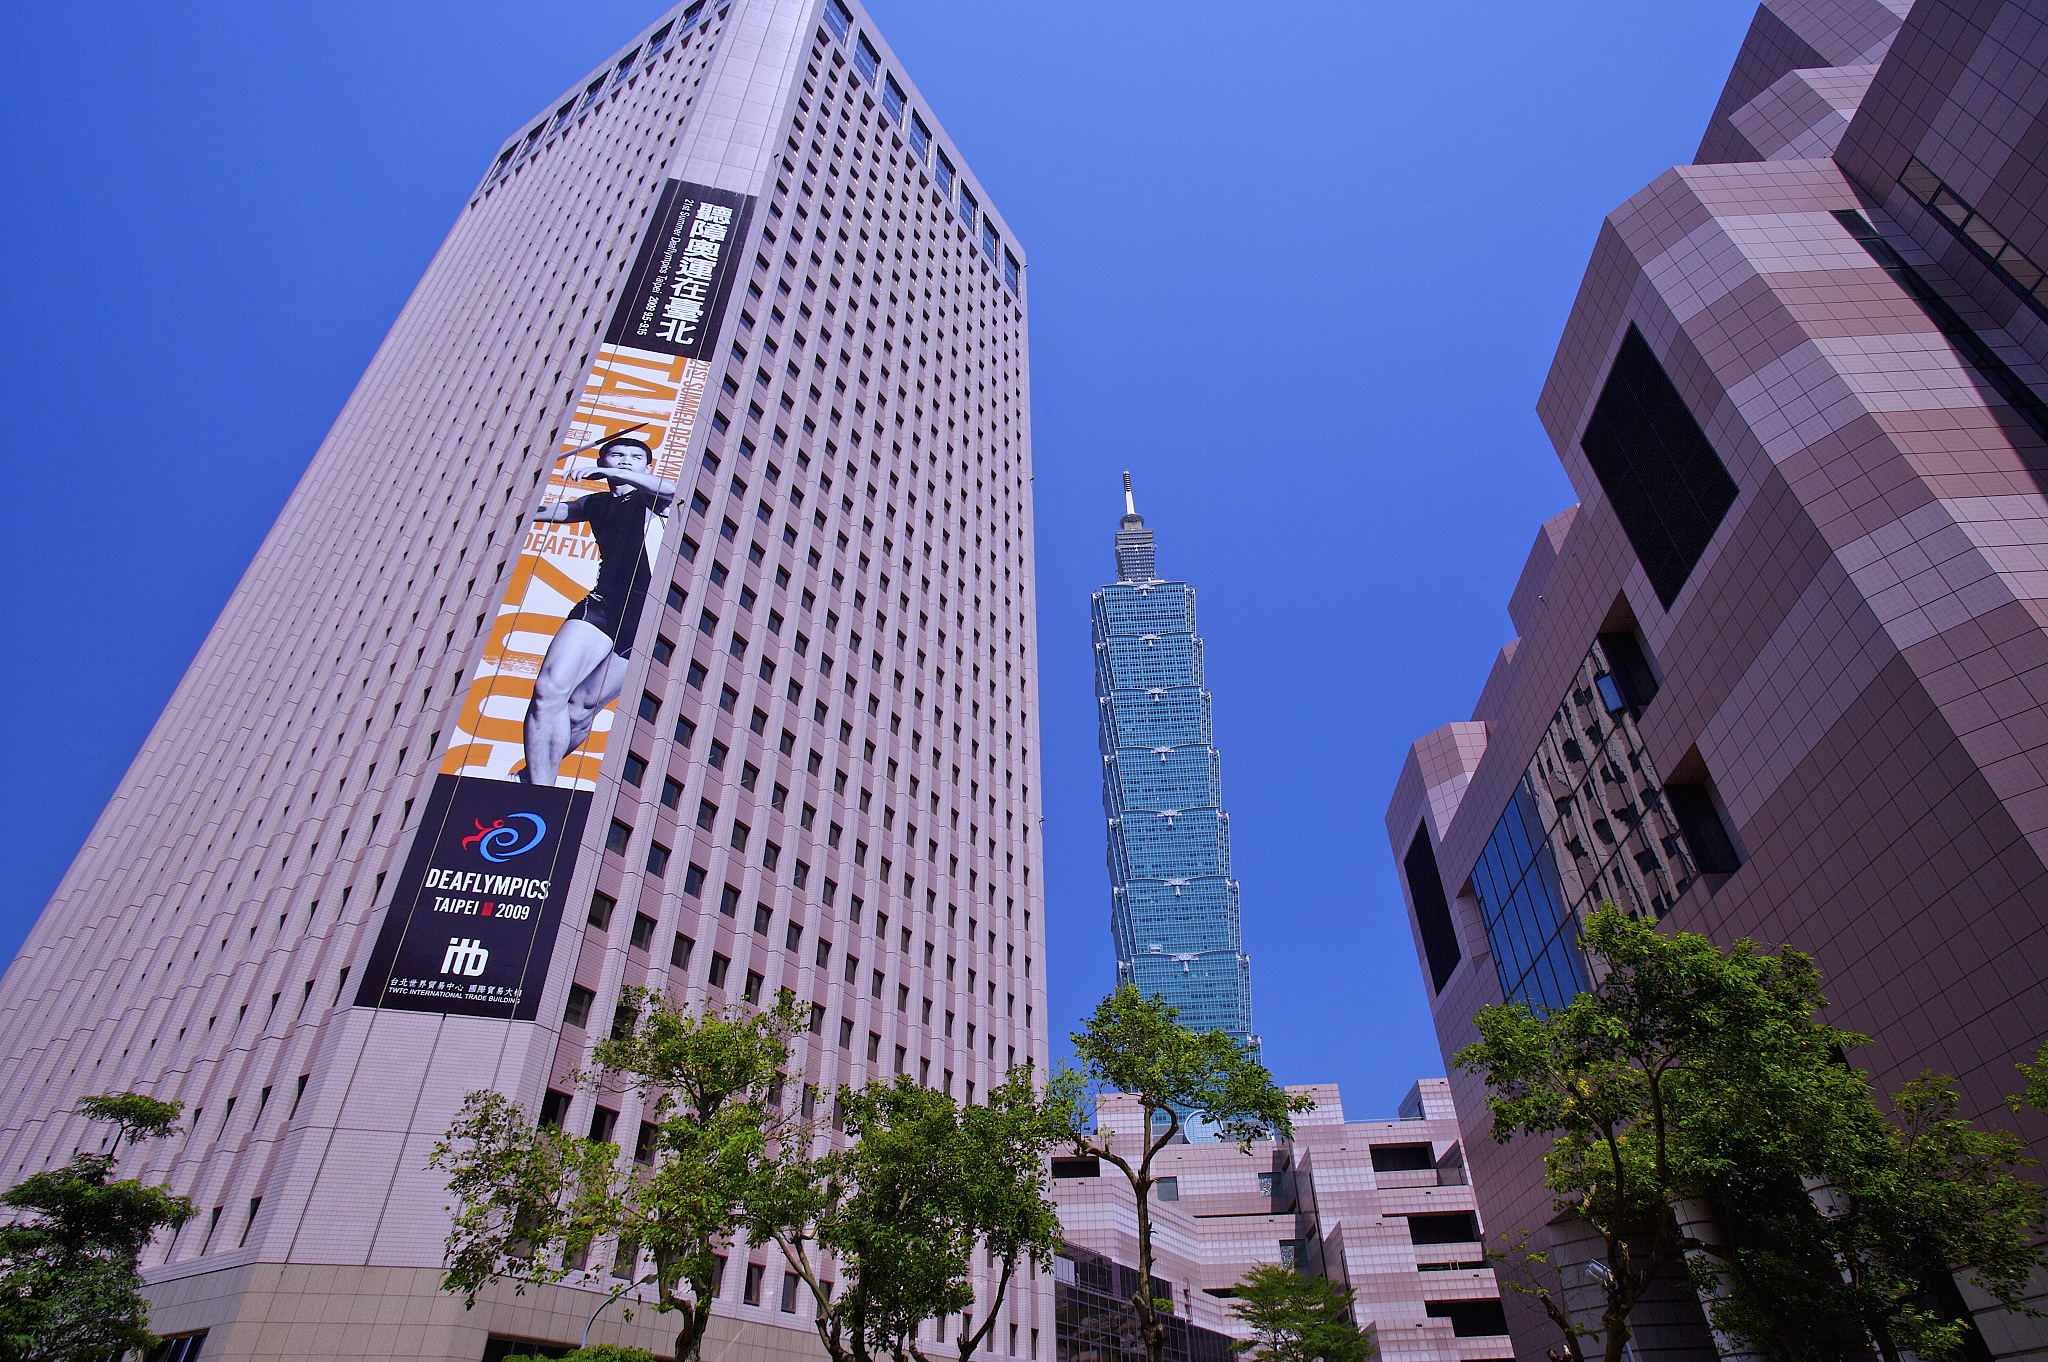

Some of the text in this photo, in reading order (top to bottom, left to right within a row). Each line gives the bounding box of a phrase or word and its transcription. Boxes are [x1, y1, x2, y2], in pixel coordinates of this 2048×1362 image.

[682, 198, 695, 211] 21st
[673, 211, 691, 236] Summer
[659, 236, 681, 274] Deaflympics
[652, 275, 668, 294] Taipei
[655, 201, 733, 345] 聽障奧運在臺北
[645, 296, 660, 311] 2009
[672, 380, 704, 426] SUMMER
[424, 868, 551, 900] DEAFLYMPICS
[433, 896, 480, 916] TAIPEI
[494, 902, 531, 921] 2009
[440, 936, 490, 977] itb
[388, 986, 521, 1005] TWTC INTERNATIONAL TRADE BUILDING
[390, 977, 464, 992] 台北世界貿易中心
